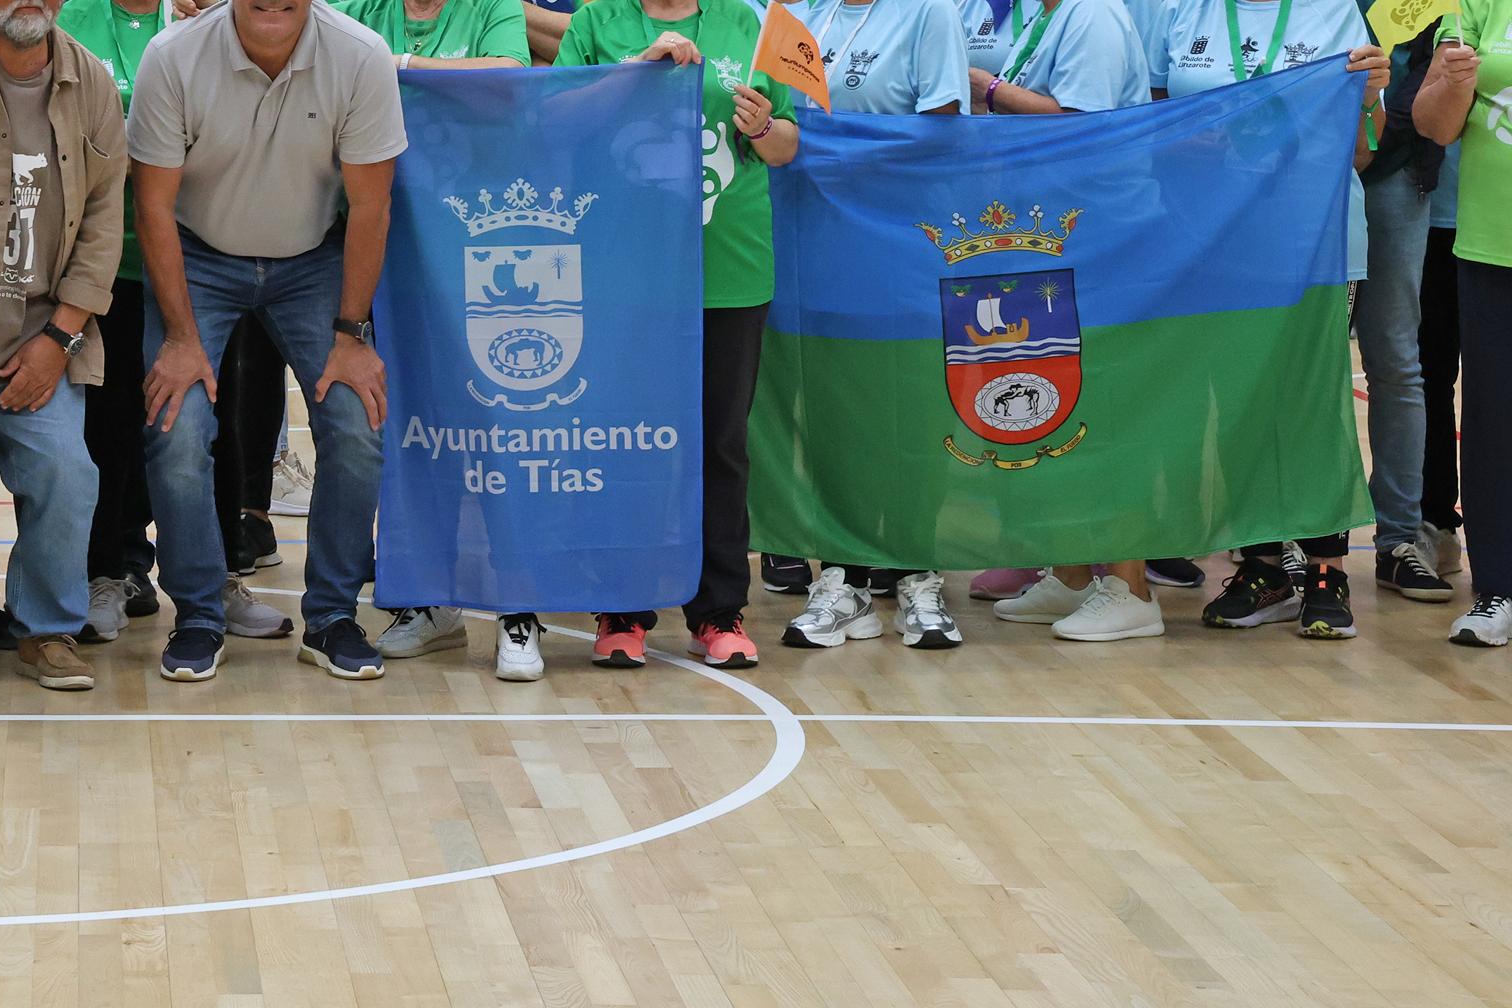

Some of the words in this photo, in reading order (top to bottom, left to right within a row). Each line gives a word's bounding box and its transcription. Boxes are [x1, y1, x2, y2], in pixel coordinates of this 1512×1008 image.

[401, 415, 678, 460] Ayuntamiento
[464, 460, 506, 494] de
[518, 458, 604, 493] Tías
